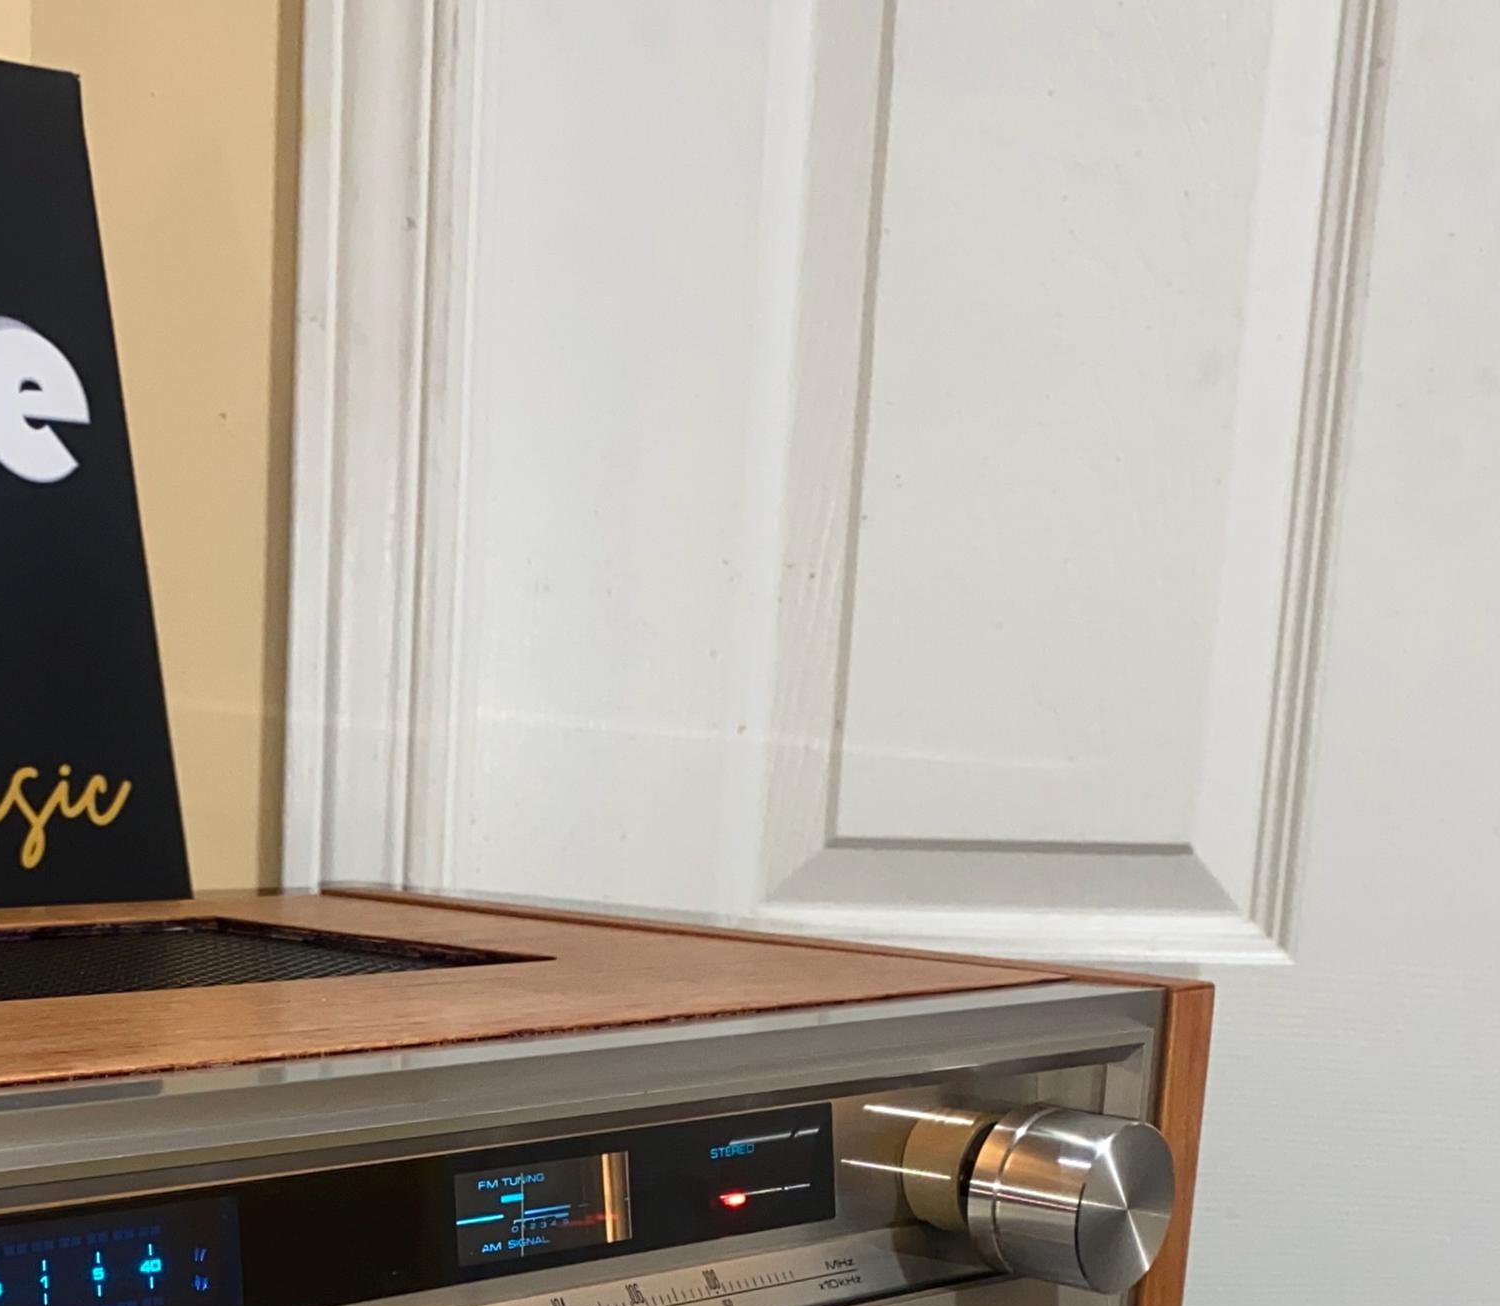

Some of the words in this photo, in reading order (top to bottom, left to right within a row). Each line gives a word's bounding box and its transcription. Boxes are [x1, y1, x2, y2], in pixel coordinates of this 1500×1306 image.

[710, 1143, 755, 1158] STEREO
[478, 1180, 498, 1190] FM
[501, 1172, 545, 1186] TUNING
[482, 1241, 502, 1253] AM
[508, 1235, 550, 1249] SIGNAL
[140, 1258, 162, 1273] 40
[825, 1258, 855, 1271] MHz
[625, 1283, 645, 1305] 106
